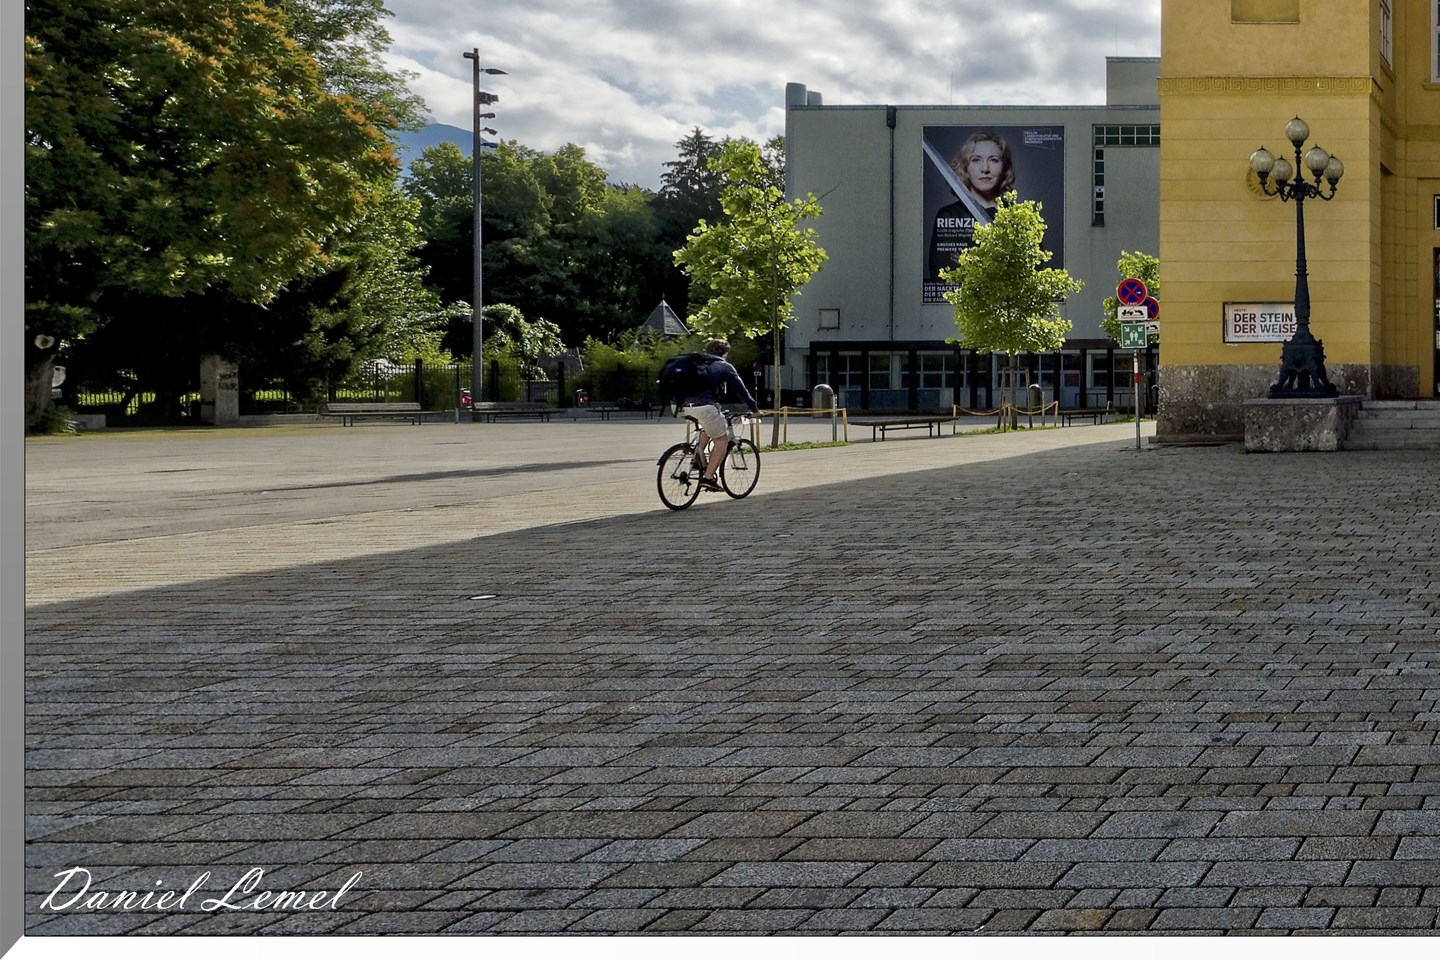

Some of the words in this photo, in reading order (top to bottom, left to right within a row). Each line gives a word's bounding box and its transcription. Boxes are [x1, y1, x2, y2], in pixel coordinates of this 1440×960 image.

[937, 218, 974, 228] RIENZI
[1234, 313, 1256, 322] DER
[1260, 313, 1292, 322] STEIN
[1234, 324, 1256, 333] DER
[1260, 324, 1296, 333] WEISE
